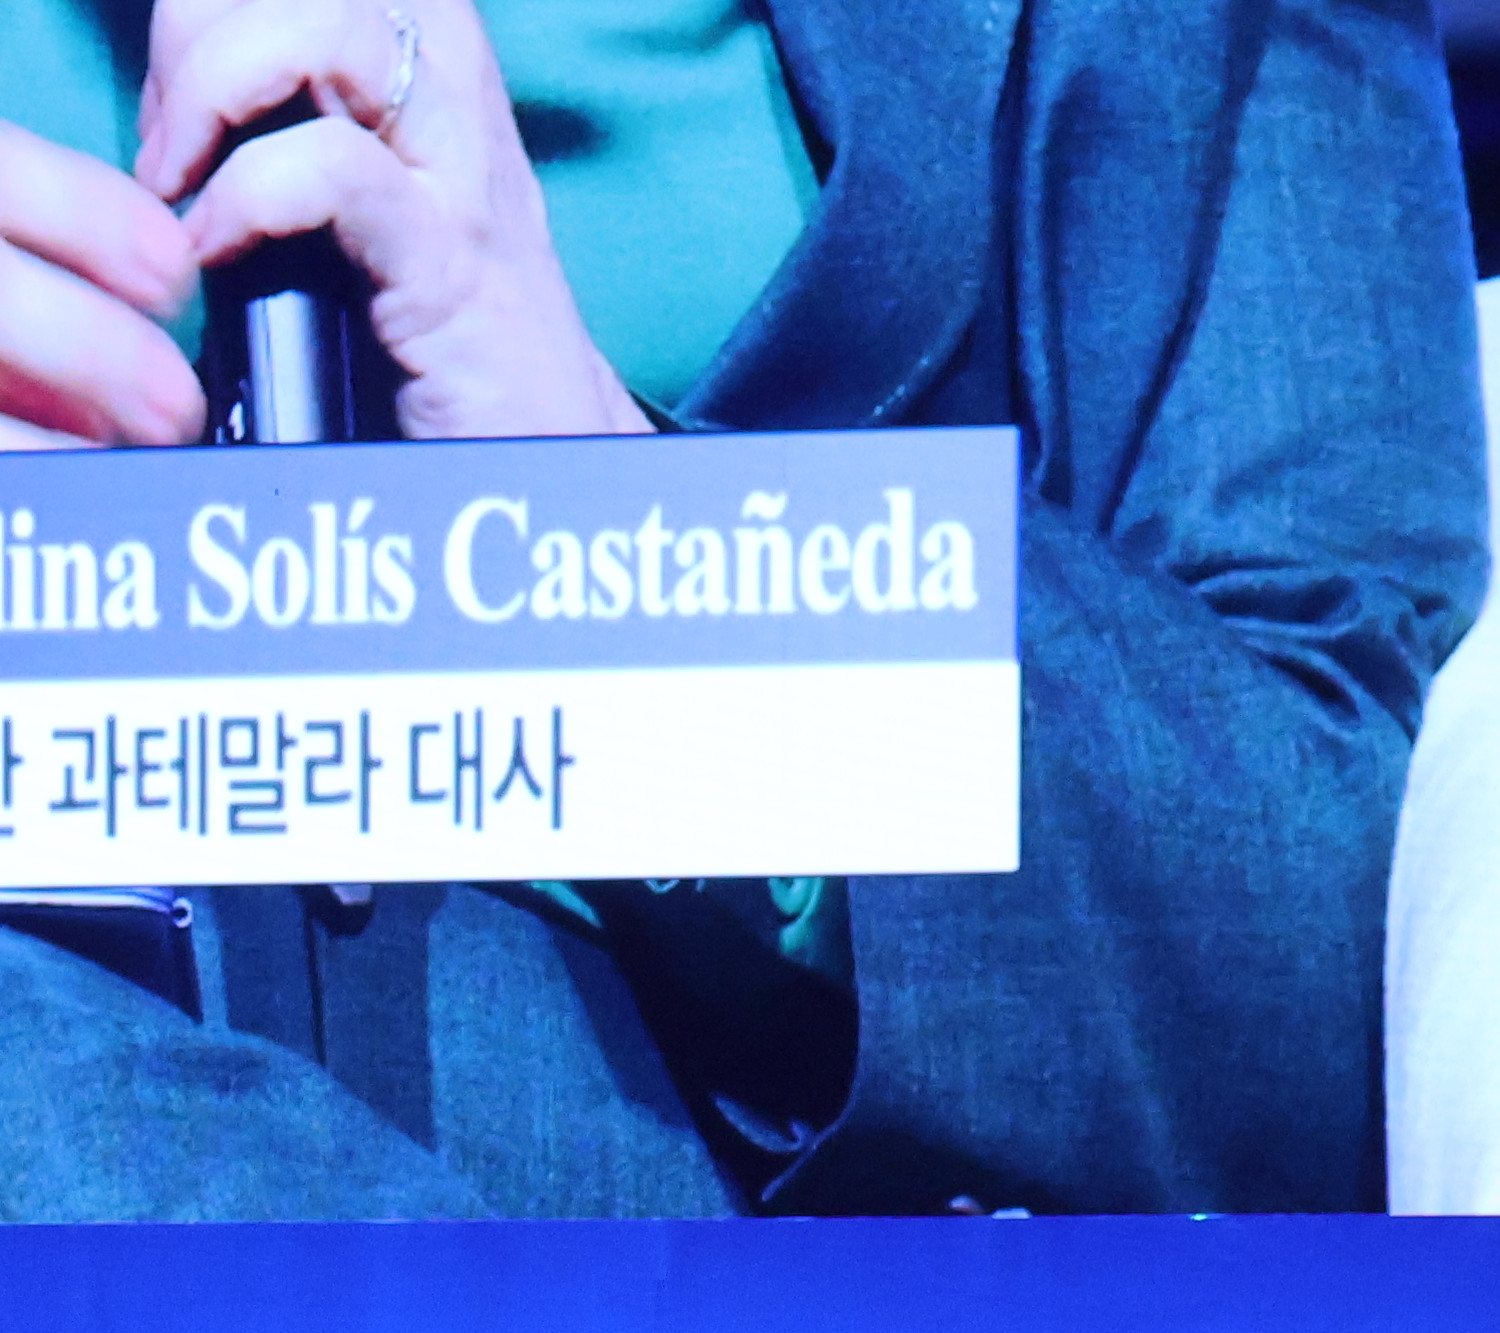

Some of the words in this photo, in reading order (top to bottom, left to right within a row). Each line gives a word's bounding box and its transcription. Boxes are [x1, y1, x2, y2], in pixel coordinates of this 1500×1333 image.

[187, 496, 418, 630] Solís
[442, 487, 981, 626] Castañeda
[50, 712, 384, 838] 과테말라
[410, 707, 576, 833] 대사
